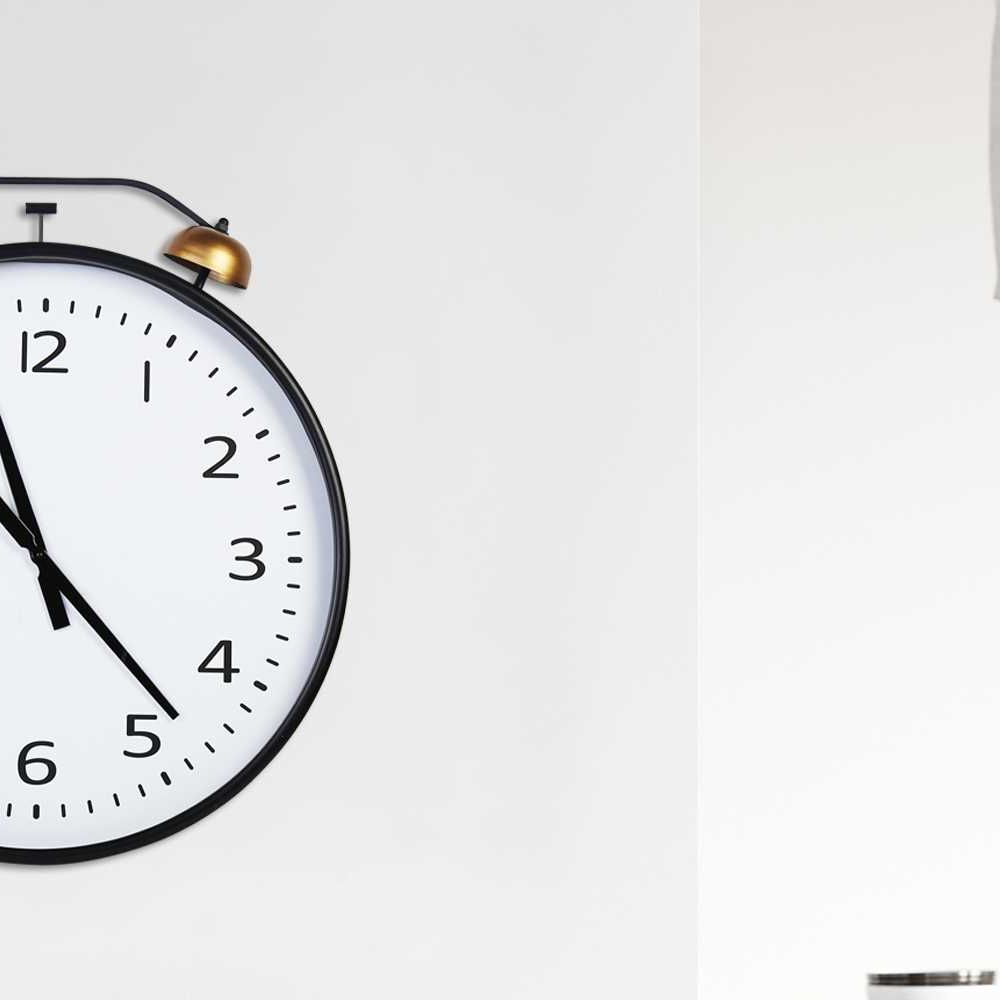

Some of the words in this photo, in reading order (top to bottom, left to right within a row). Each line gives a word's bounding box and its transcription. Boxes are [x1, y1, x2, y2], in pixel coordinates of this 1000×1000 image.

[22, 331, 68, 373] 12
[143, 360, 151, 403] 1
[203, 436, 239, 478] 2
[229, 538, 265, 580] 3
[198, 640, 239, 683] 4
[124, 715, 160, 758] 5
[18, 741, 56, 785] 6
